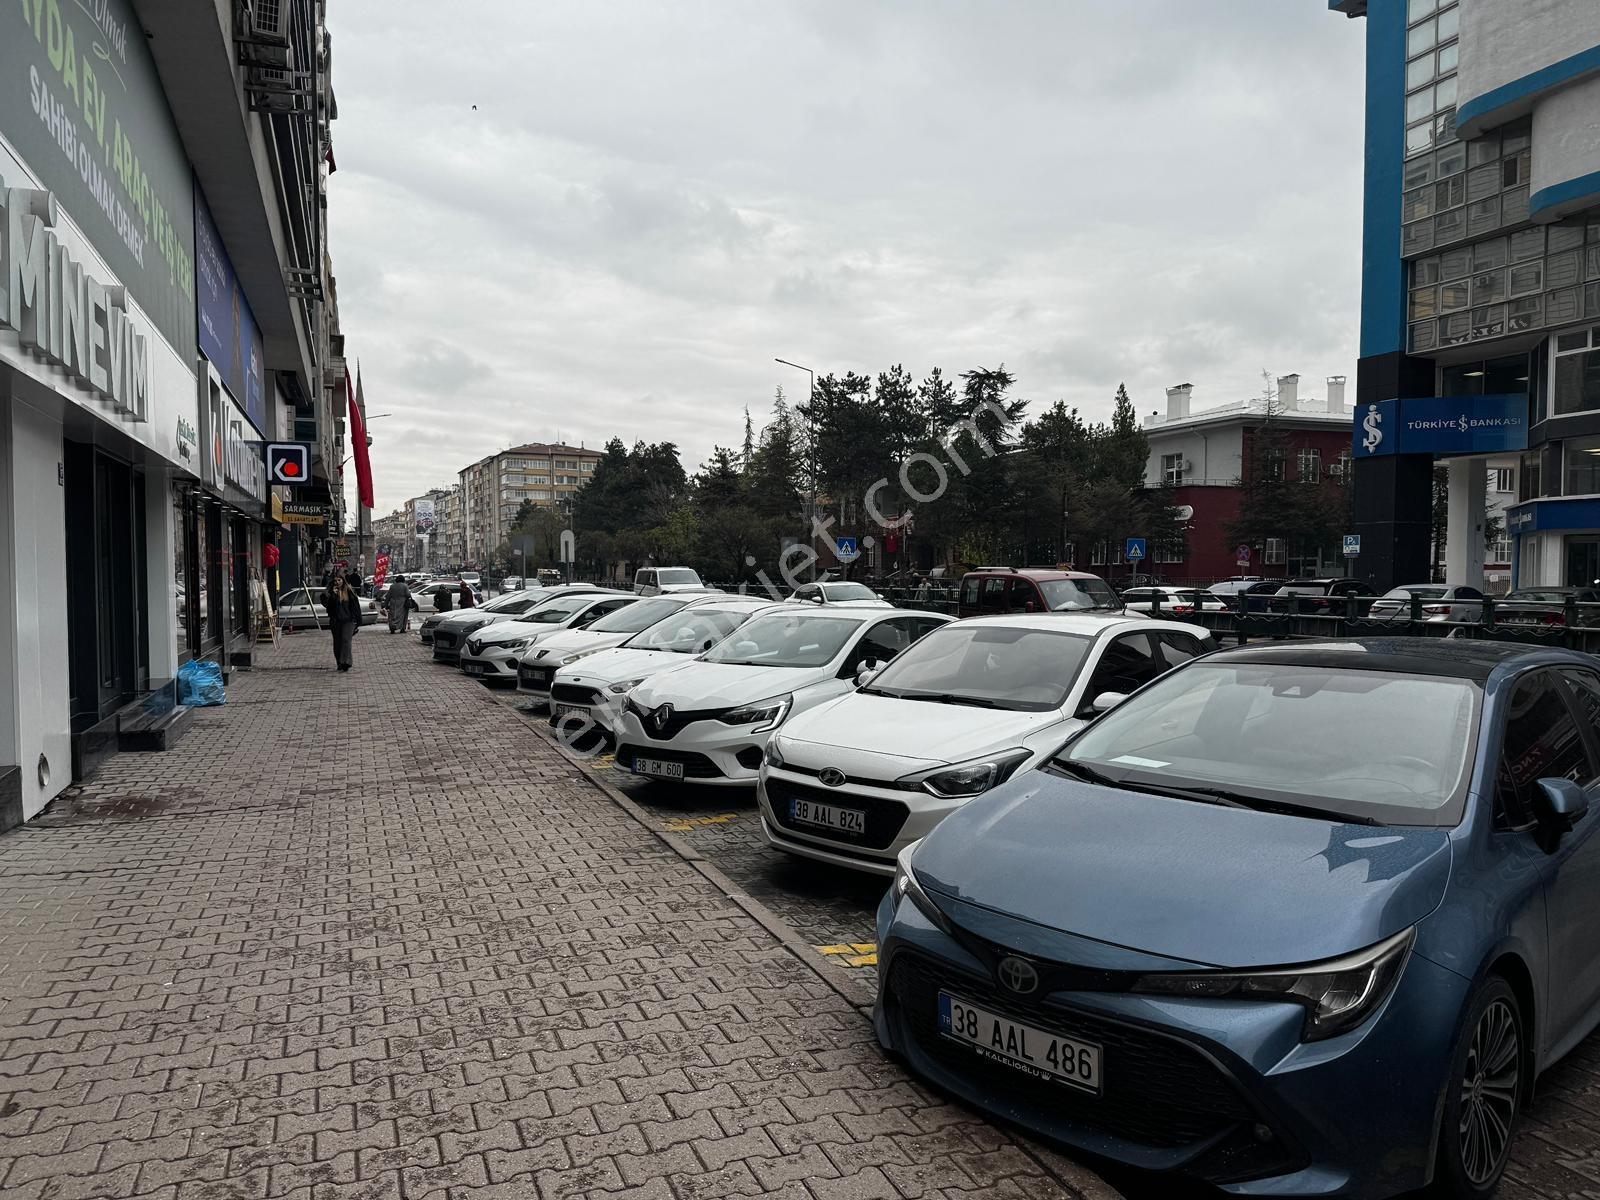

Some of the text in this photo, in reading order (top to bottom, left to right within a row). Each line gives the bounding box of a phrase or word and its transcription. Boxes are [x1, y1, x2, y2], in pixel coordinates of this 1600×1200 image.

[30, 64, 145, 270] SAHİBİ OLMAK DEMEK
[113, 118, 150, 244] ARAÇ
[151, 187, 165, 255] VE
[0, 170, 149, 423] MİNEVİM
[1407, 418, 1457, 430] TÜRKİYE
[1470, 417, 1521, 428] BANKASI
[284, 504, 321, 514] SARMAŞIK
[637, 759, 647, 772] 38
[666, 763, 682, 777] 600
[795, 801, 809, 819] 38
[813, 805, 835, 825] AAL
[839, 810, 863, 831] 824
[953, 1004, 979, 1039] 38
[991, 1019, 1034, 1061] AAL
[1046, 1039, 1092, 1080] 486
[985, 1050, 1040, 1077] KALELİOĞLU
